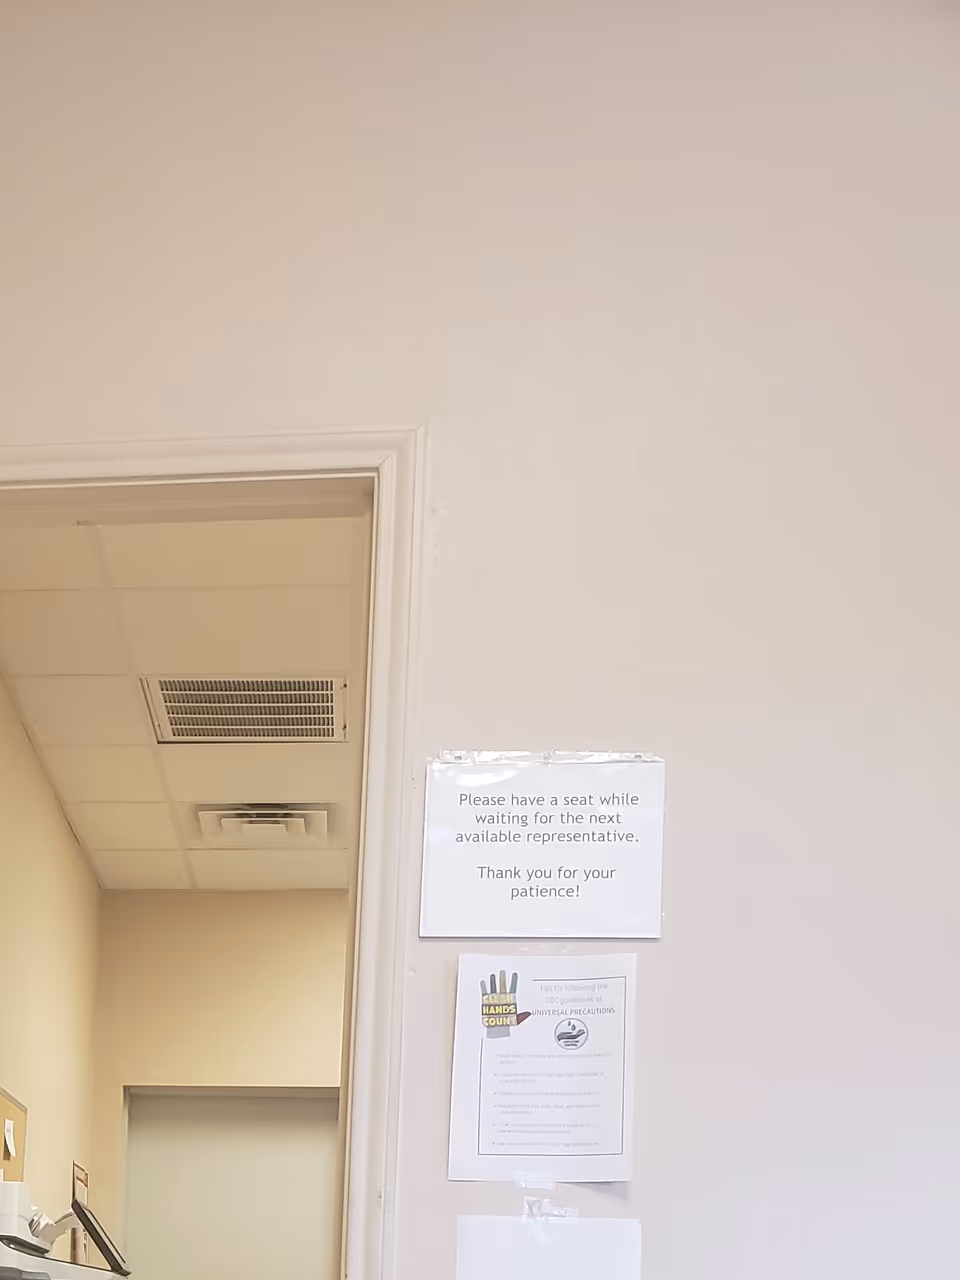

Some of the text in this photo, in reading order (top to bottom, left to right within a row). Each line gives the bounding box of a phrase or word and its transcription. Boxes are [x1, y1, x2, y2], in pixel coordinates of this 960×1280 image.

[459, 793, 640, 806] Please have a seat while
[475, 811, 622, 827] waiting for the next
[455, 829, 639, 845] available representative.
[477, 865, 616, 882] Thank you for your
[510, 885, 580, 900] patience!
[482, 1004, 516, 1014] HANDS
[532, 1007, 616, 1016] UNIVERSAL PRECAUTIONS
[482, 1016, 516, 1026] COUNT
